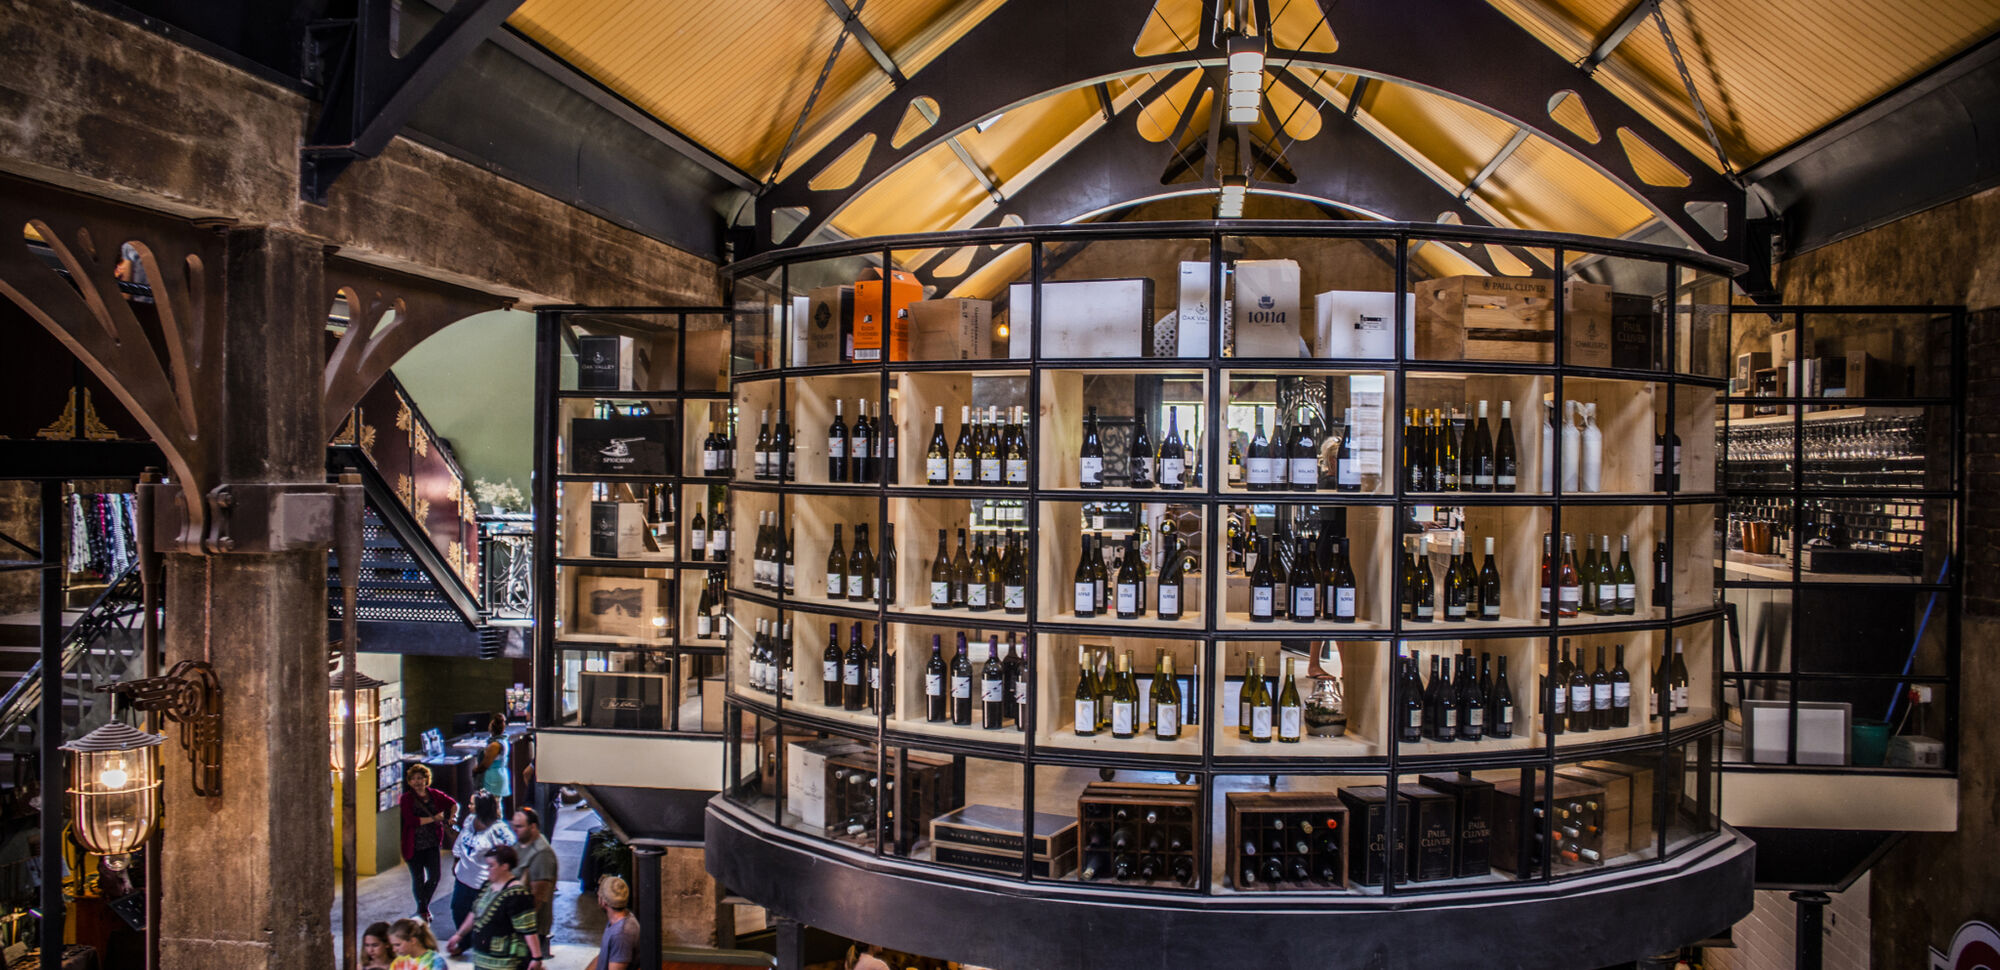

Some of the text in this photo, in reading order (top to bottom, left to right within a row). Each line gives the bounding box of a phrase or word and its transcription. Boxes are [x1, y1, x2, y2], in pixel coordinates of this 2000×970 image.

[1492, 281, 1512, 291] PAUL
[1468, 821, 1486, 830] PAUL
[1427, 830, 1448, 838] PAUL
[1463, 829, 1490, 839] CLUVER
[1421, 838, 1451, 848] CLUVER
